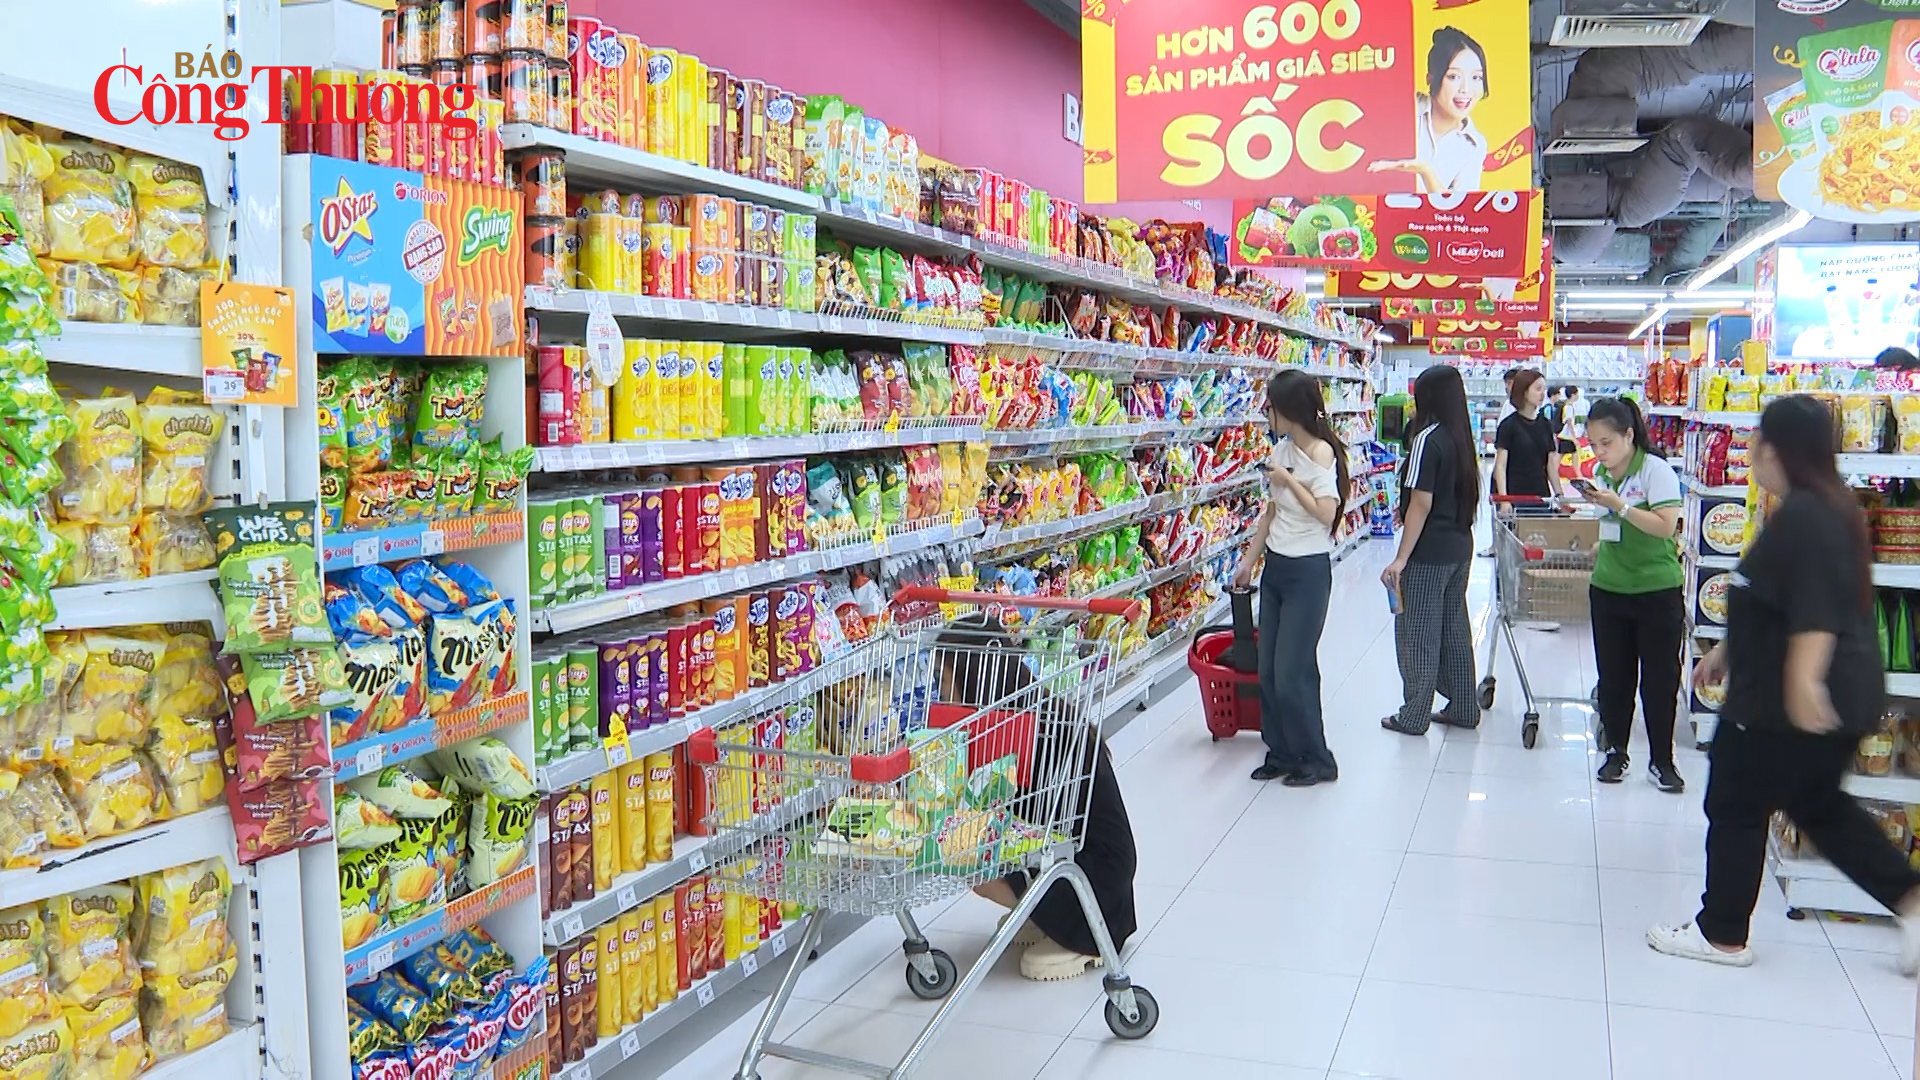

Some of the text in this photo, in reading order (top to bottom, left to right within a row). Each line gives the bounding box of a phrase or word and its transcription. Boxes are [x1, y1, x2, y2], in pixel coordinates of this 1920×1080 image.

[1156, 0, 1361, 60] HƠN 600
[1125, 44, 1395, 96] SẢN PHẨM GIÁ SIÊU
[1159, 83, 1365, 187] SỐC
[410, 187, 447, 204] ORION
[322, 190, 374, 244] O'Star
[465, 208, 511, 254] Swing
[1451, 247, 1504, 258] MEAT Deli
[216, 299, 234, 313] 100
[207, 309, 237, 330] SNACK
[393, 537, 419, 549] ORION
[402, 734, 426, 750] ORION
